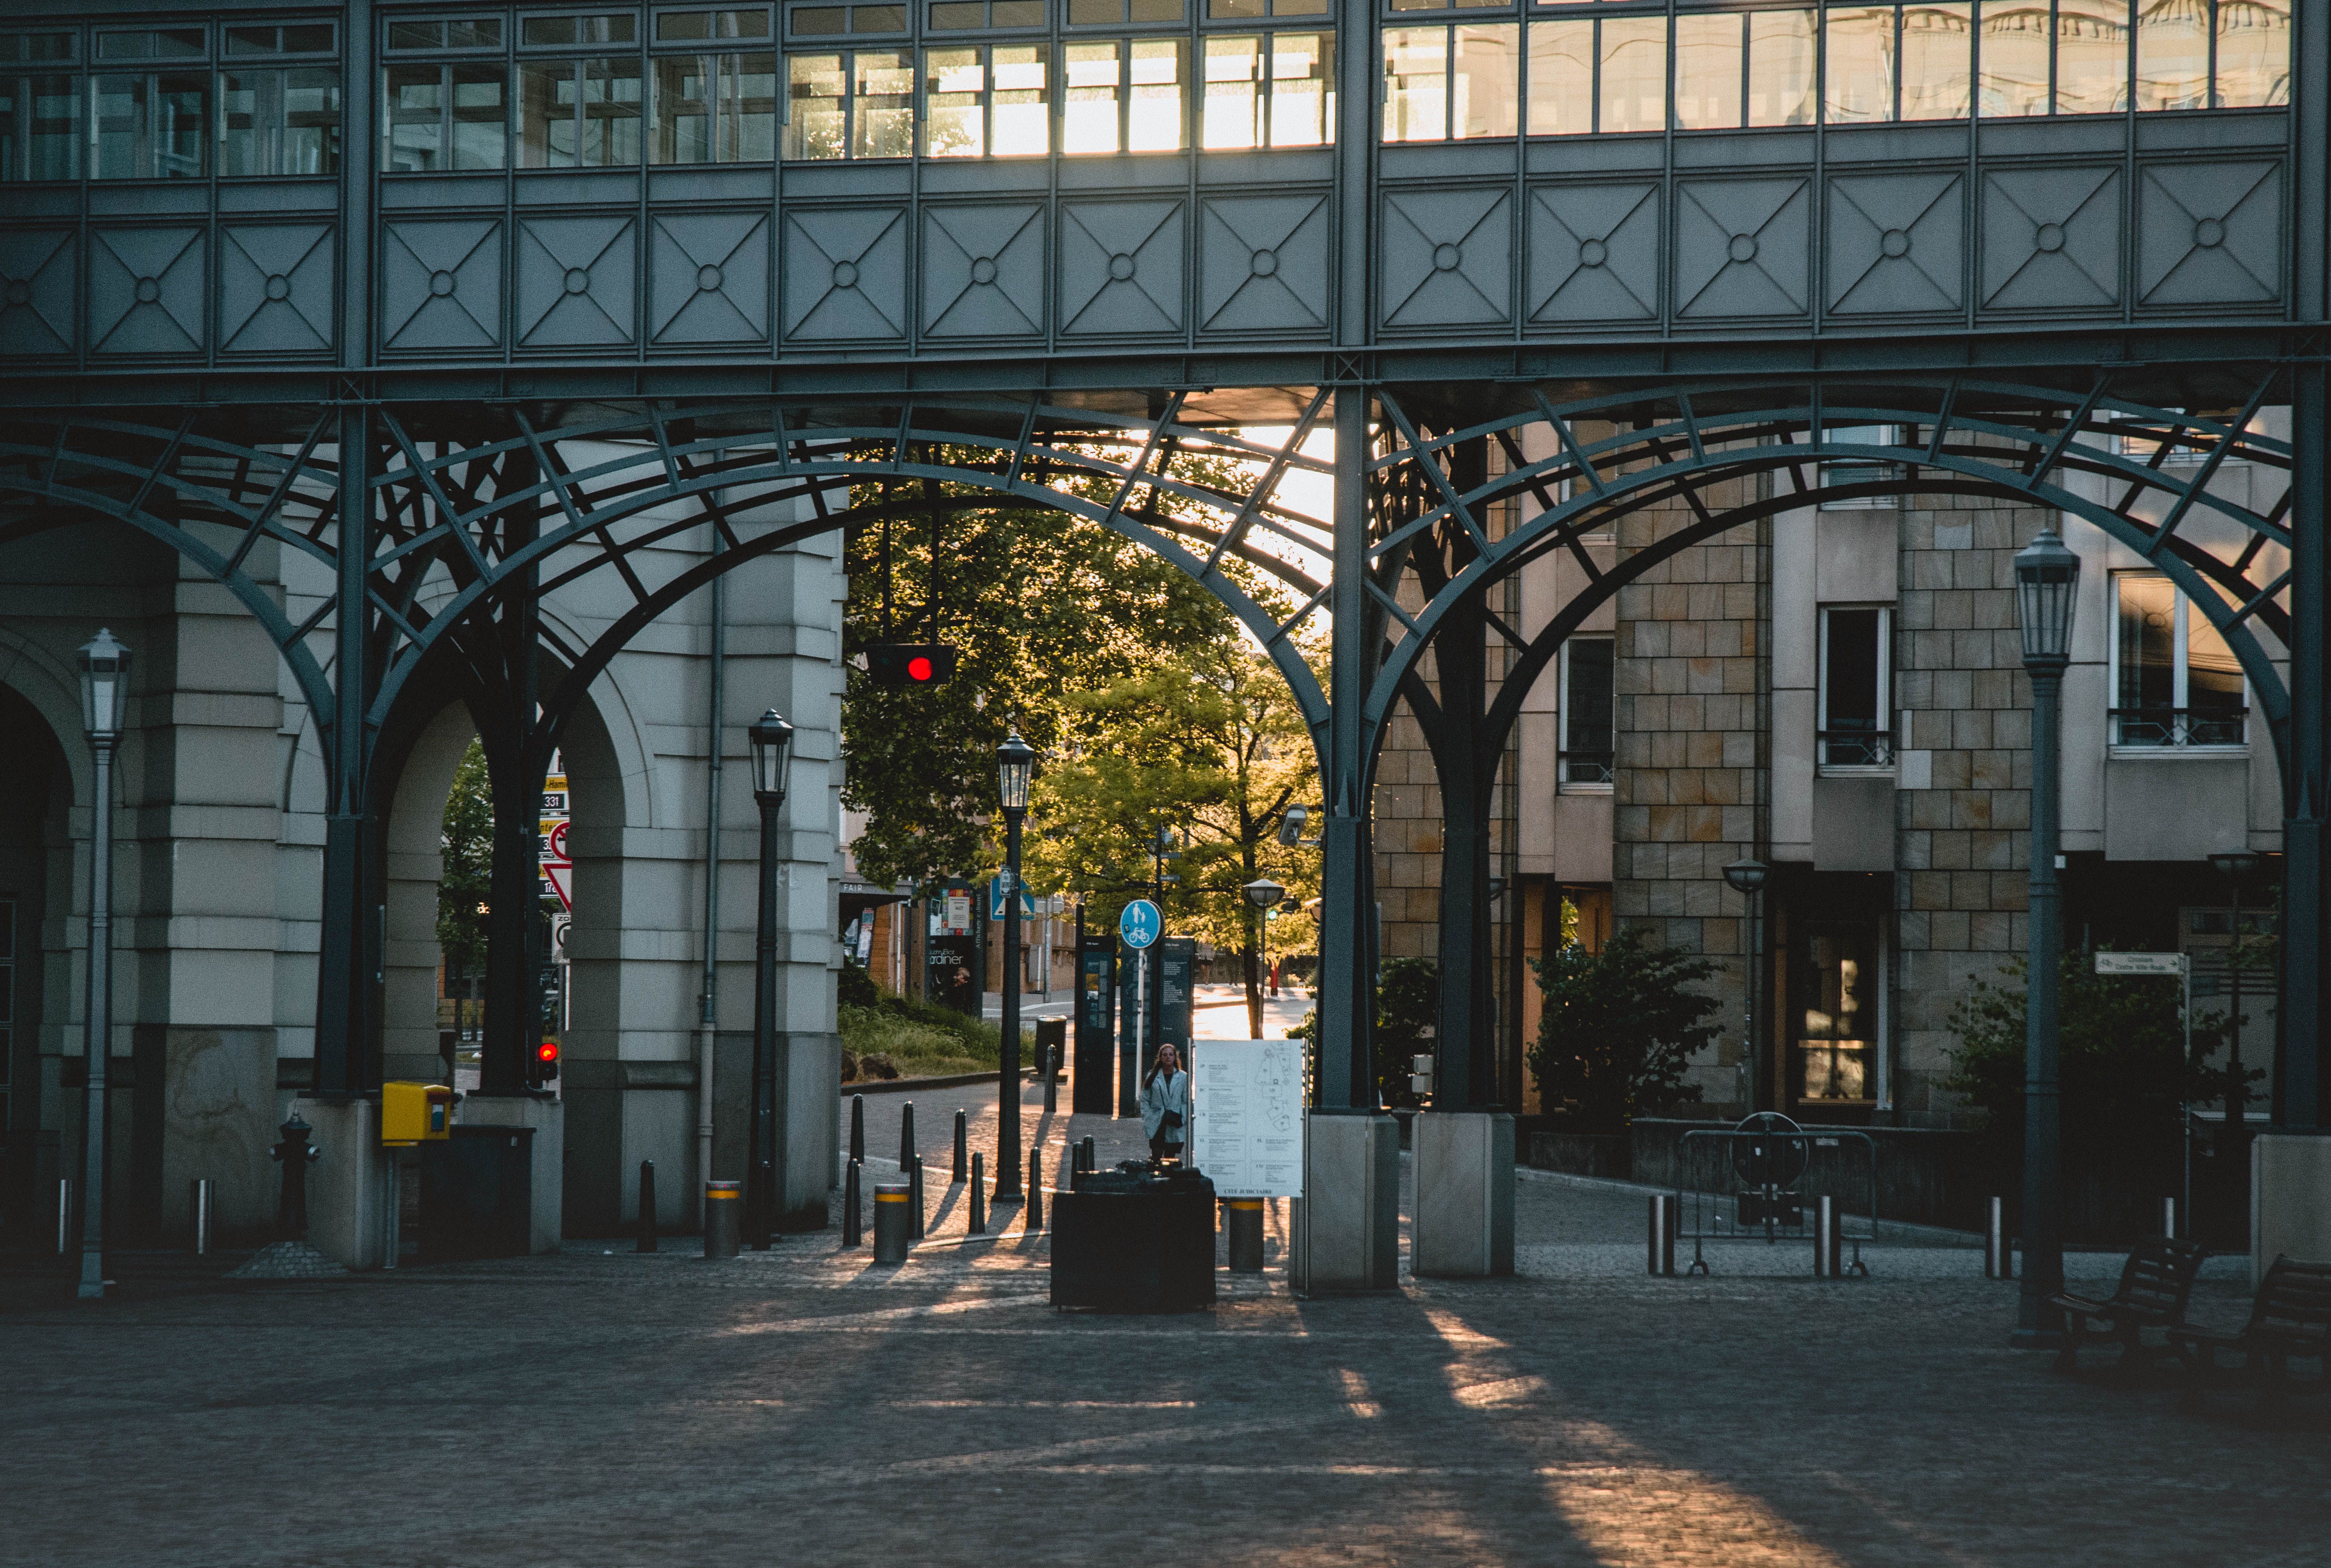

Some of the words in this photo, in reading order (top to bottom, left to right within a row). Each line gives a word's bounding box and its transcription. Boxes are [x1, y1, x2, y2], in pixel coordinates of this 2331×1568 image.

[544, 796, 559, 807] 331
[543, 839, 551, 850] 3
[844, 883, 863, 892] FAIR
